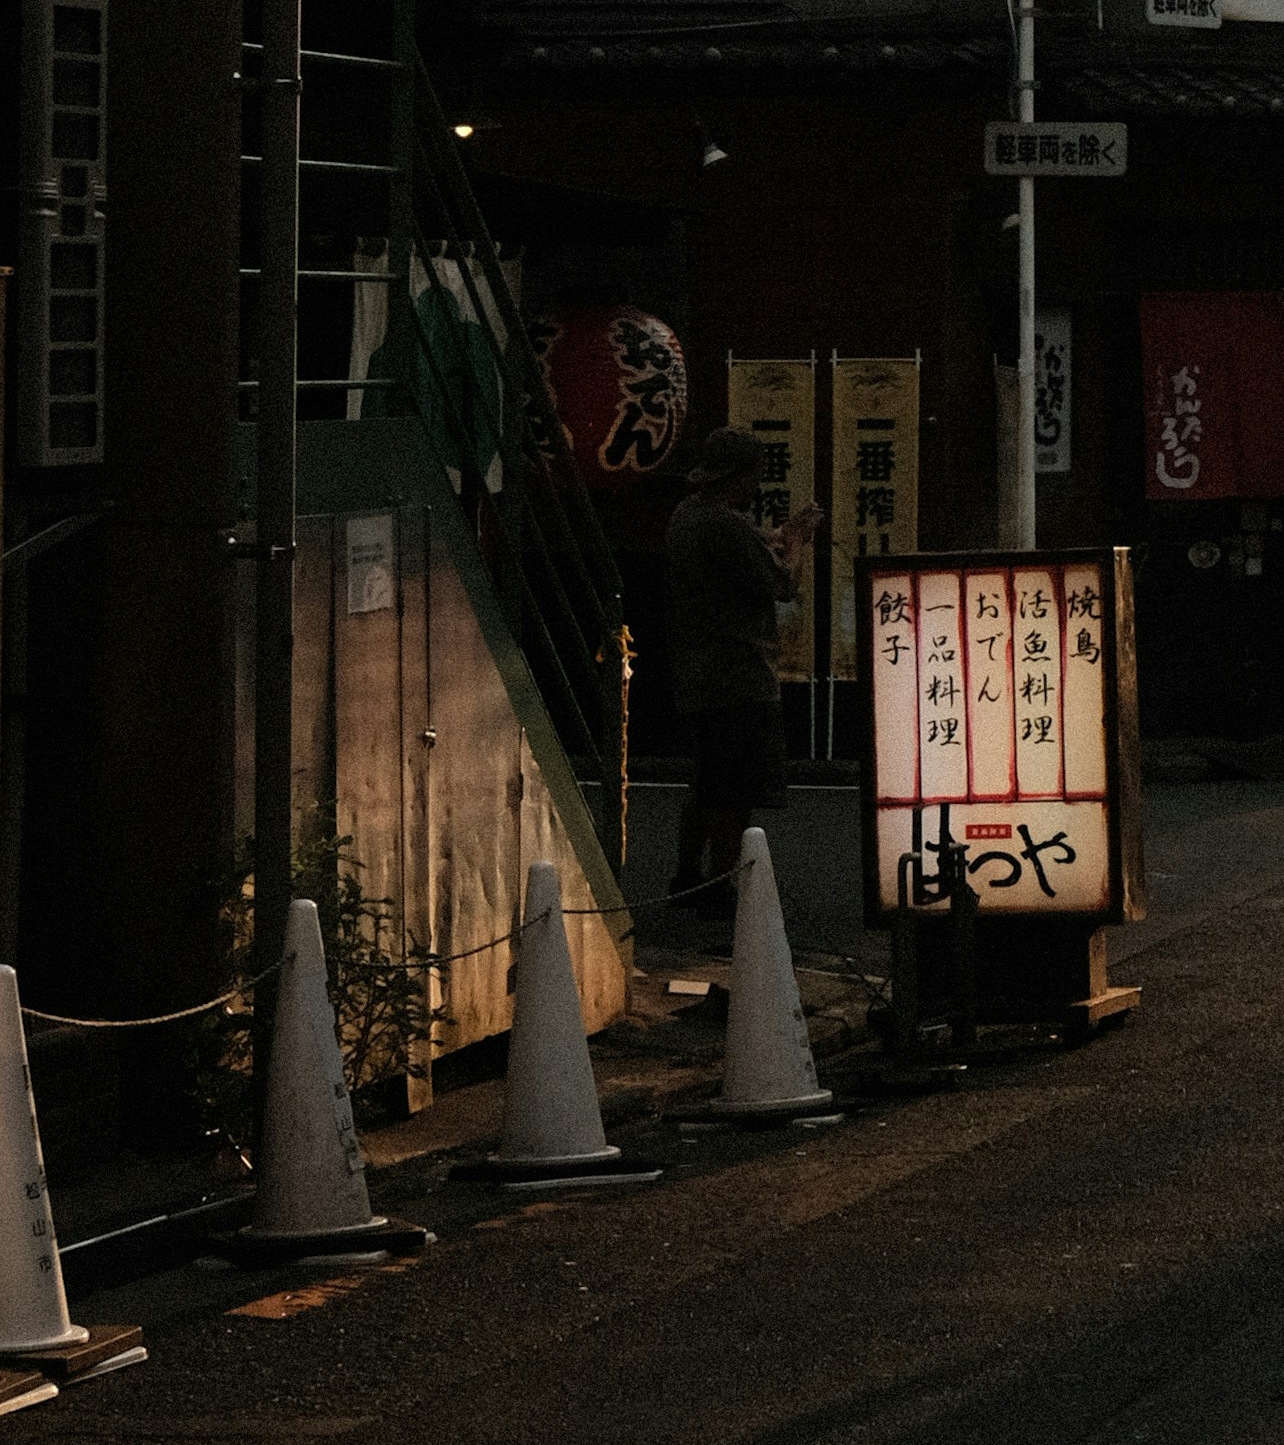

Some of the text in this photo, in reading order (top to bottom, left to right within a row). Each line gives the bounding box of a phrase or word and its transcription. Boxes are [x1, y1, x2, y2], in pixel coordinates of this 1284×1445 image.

[994, 130, 1116, 166] 軽車両を除く
[607, 319, 674, 468] おでん
[874, 589, 913, 665] 餃子
[924, 601, 962, 746] 一品料理
[975, 591, 1001, 703] おでん
[1018, 590, 1056, 745] 活魚料理
[1068, 589, 1103, 665] 焼鳥
